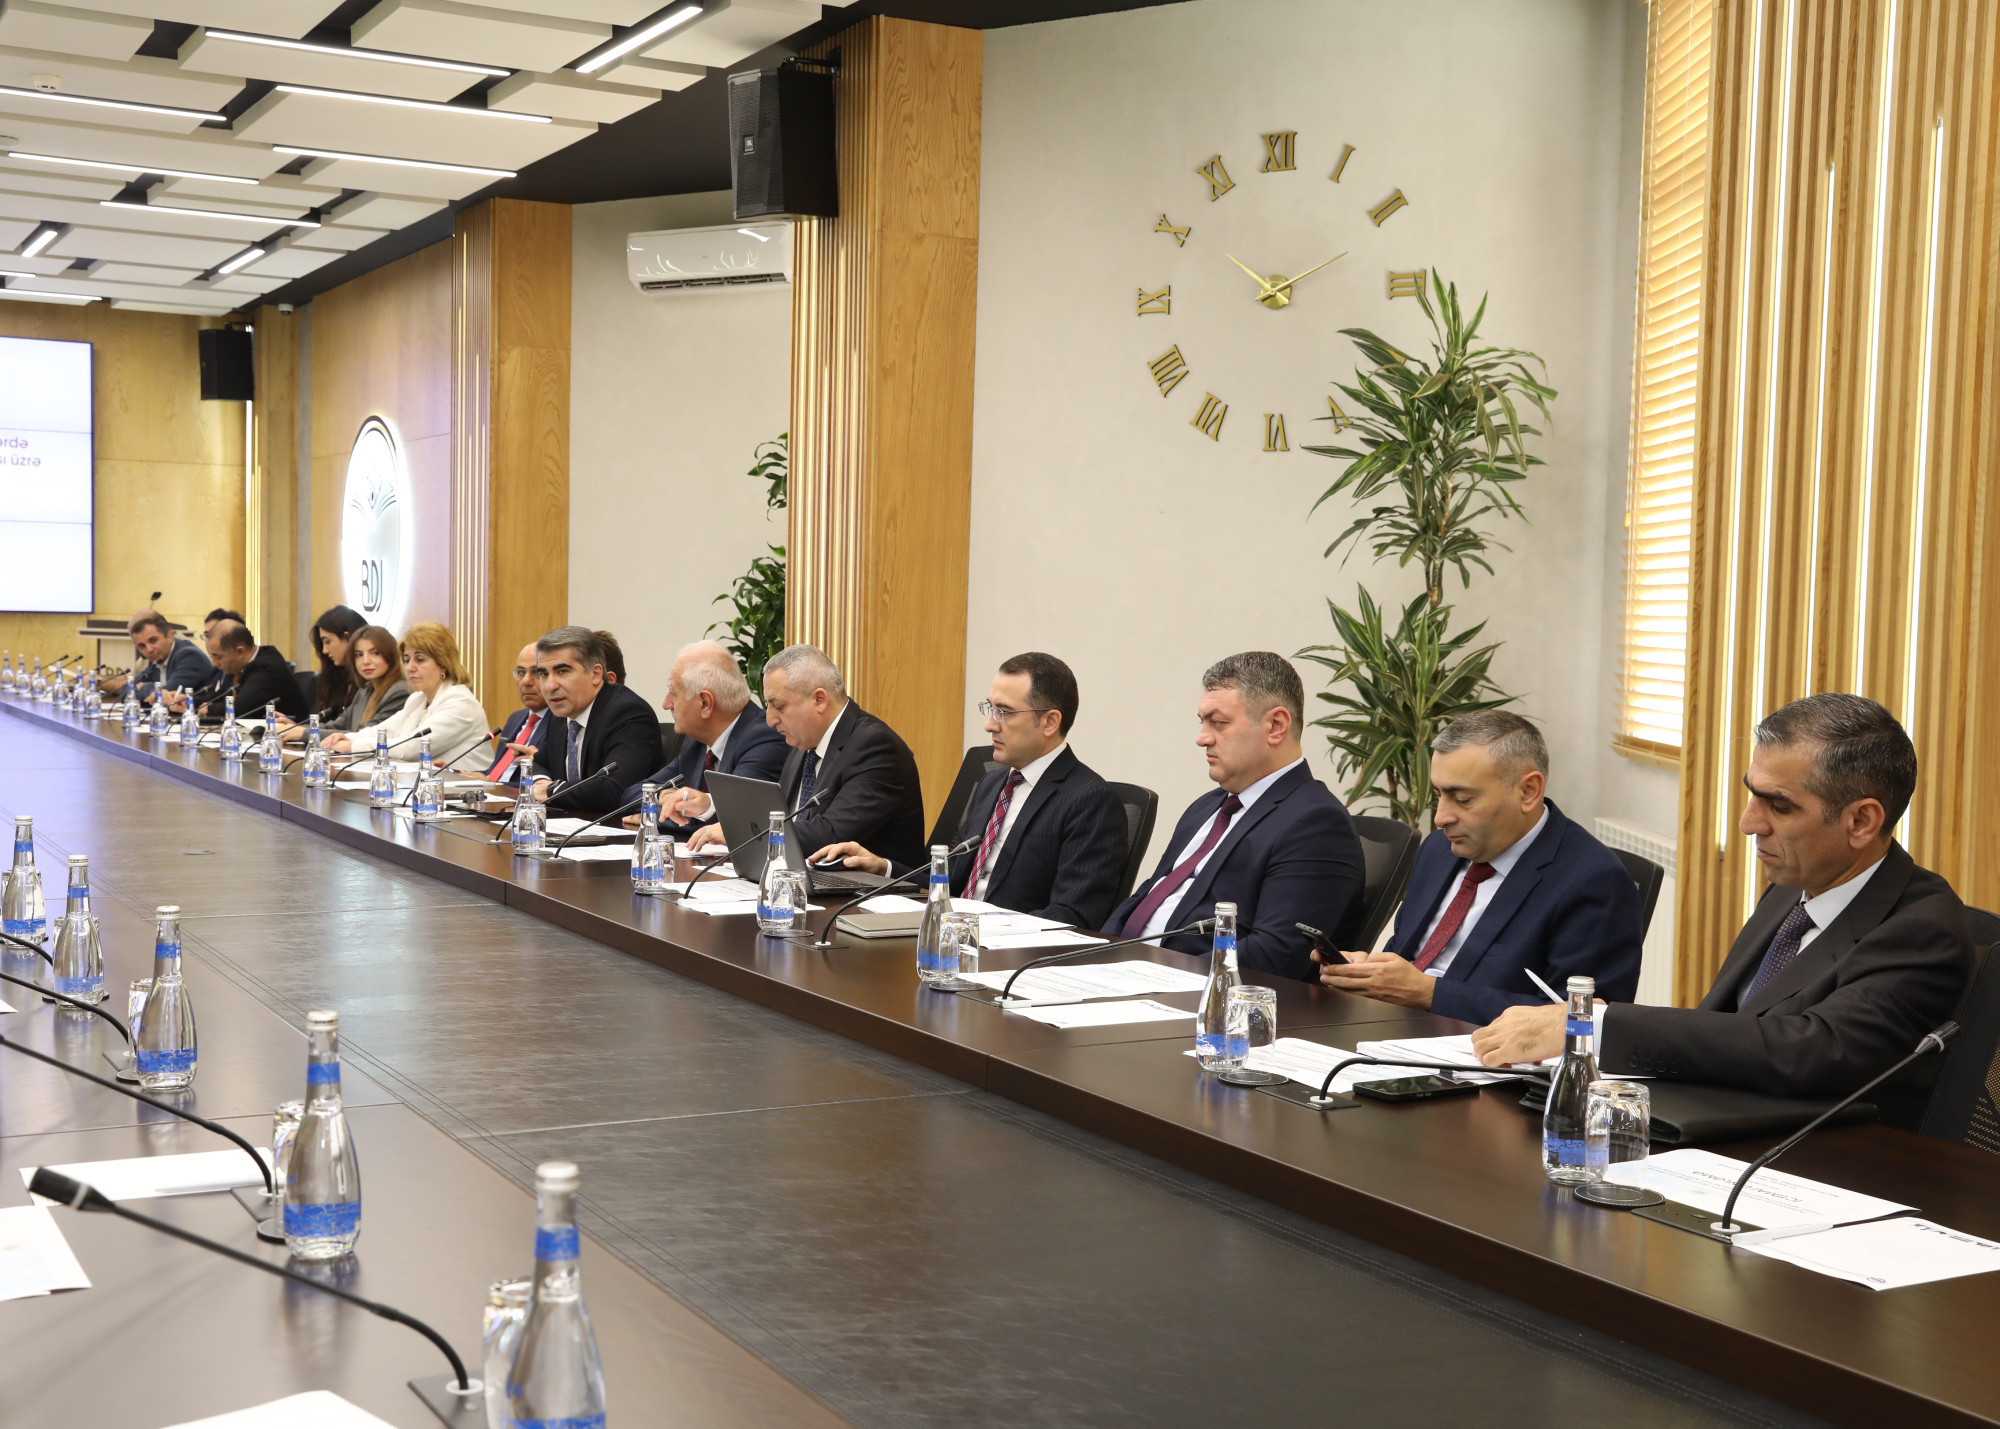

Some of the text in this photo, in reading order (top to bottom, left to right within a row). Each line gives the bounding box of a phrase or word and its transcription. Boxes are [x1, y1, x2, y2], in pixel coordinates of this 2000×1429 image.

[1261, 131, 1297, 173] XII
[1329, 143, 1356, 184] I
[1197, 155, 1236, 202] XI
[1368, 188, 1409, 228] II
[1154, 213, 1192, 248] X
[1137, 285, 1171, 316] IX
[1388, 269, 1427, 300] III
[1147, 343, 1190, 398] VIII
[1189, 391, 1229, 442] VII
[1262, 413, 1290, 451] VI
[10, 453, 42, 467] üzrə
